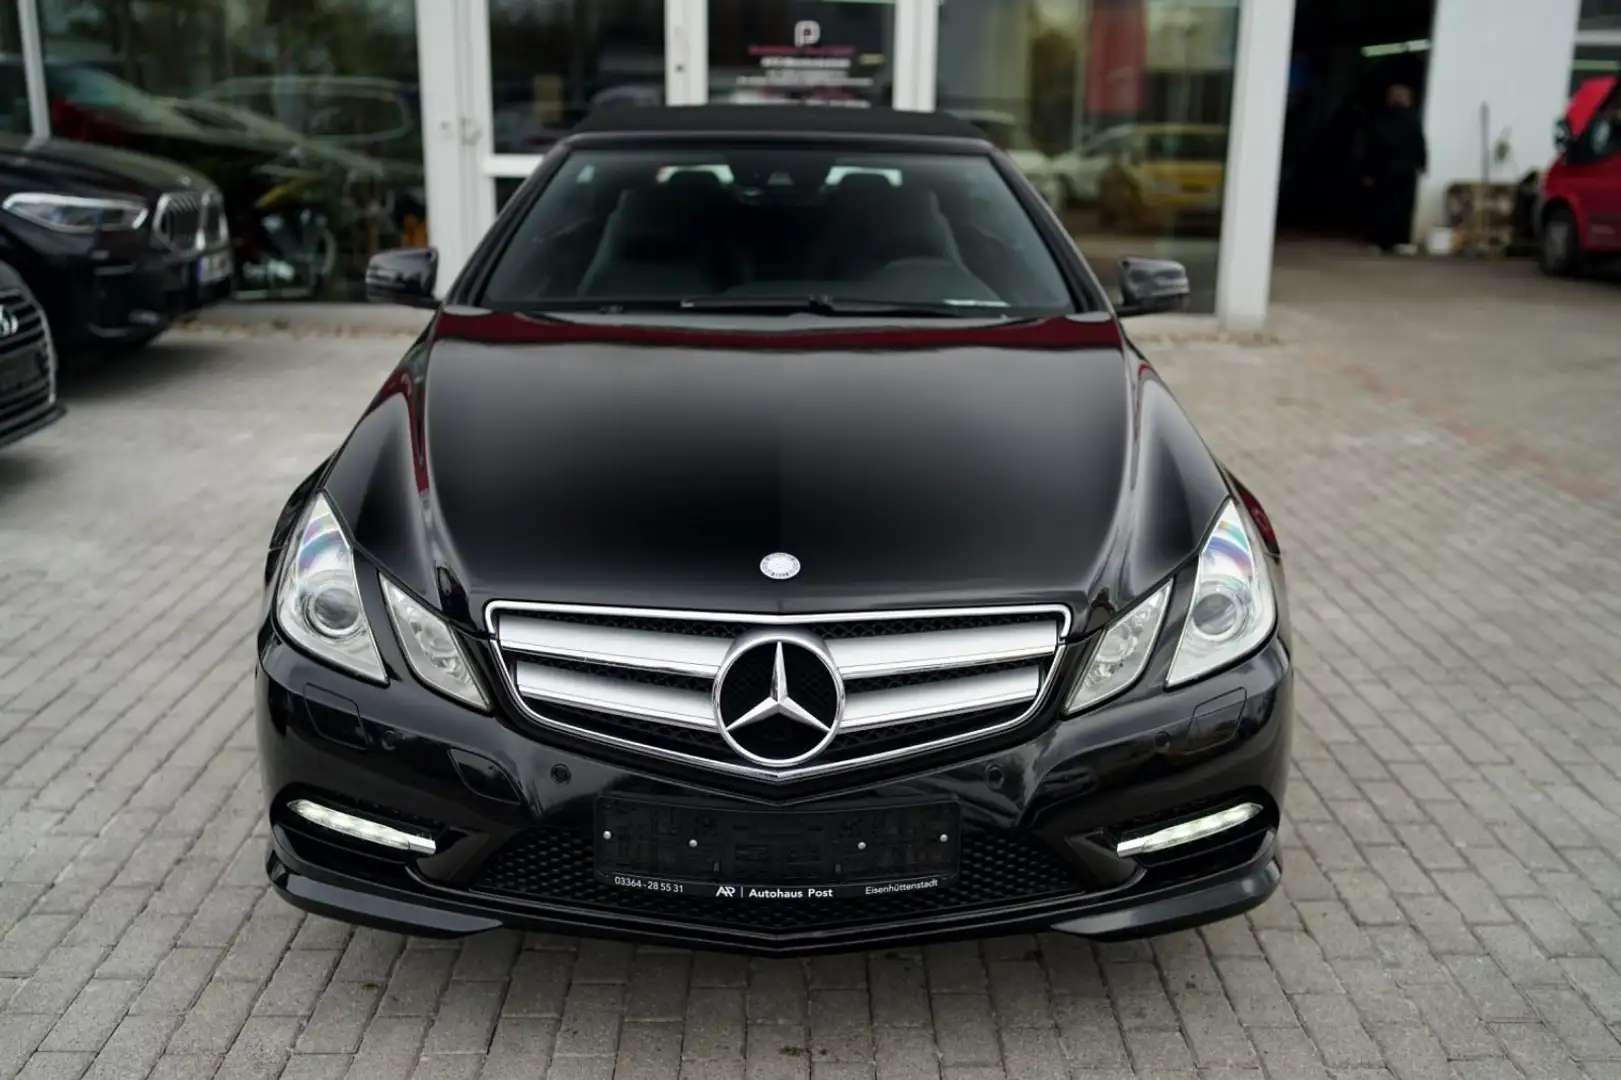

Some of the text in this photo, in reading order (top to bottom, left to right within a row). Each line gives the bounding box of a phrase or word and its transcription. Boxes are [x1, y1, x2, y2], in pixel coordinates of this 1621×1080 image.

[660, 882, 671, 892] 55
[673, 884, 683, 893] 31
[865, 878, 938, 895] Eisenhüttenstadt
[749, 888, 803, 898] Autohaus
[808, 888, 833, 898] Post
